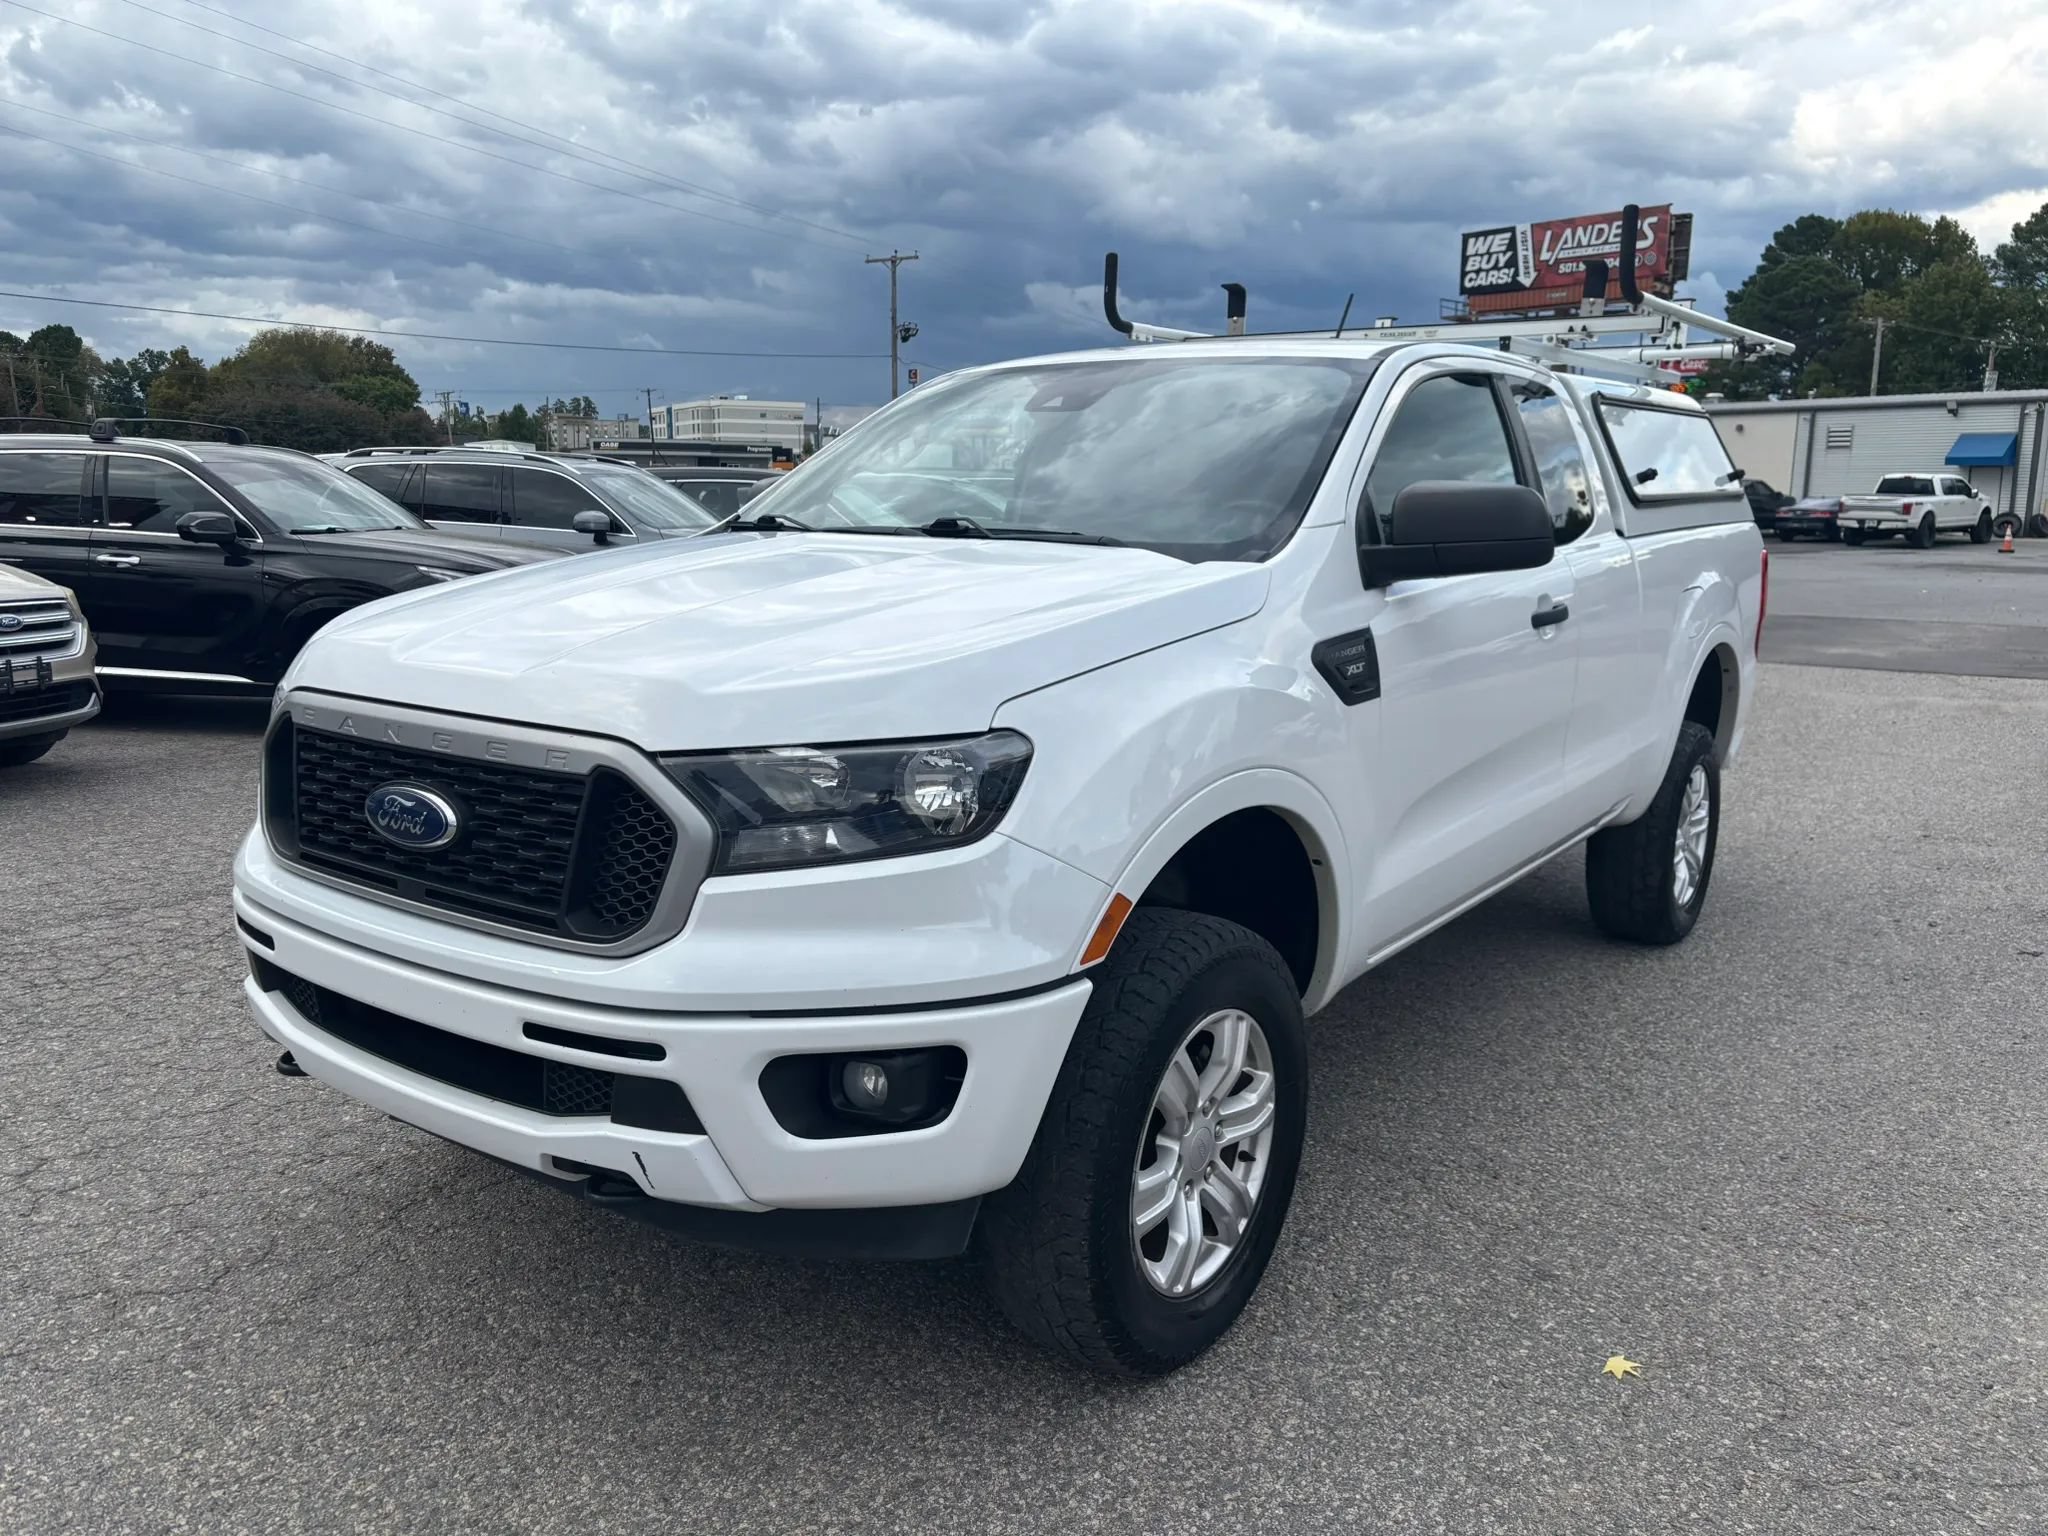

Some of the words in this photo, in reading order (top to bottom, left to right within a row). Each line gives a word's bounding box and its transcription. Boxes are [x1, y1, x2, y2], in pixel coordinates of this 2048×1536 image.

[1466, 232, 1512, 256] WE
[1520, 230, 1529, 252] VISIT
[1540, 216, 1658, 265] LANDES
[1465, 252, 1513, 272] BUY
[1464, 268, 1515, 289] CARS!
[1345, 662, 1366, 676] XLT
[377, 795, 425, 836] Ford
